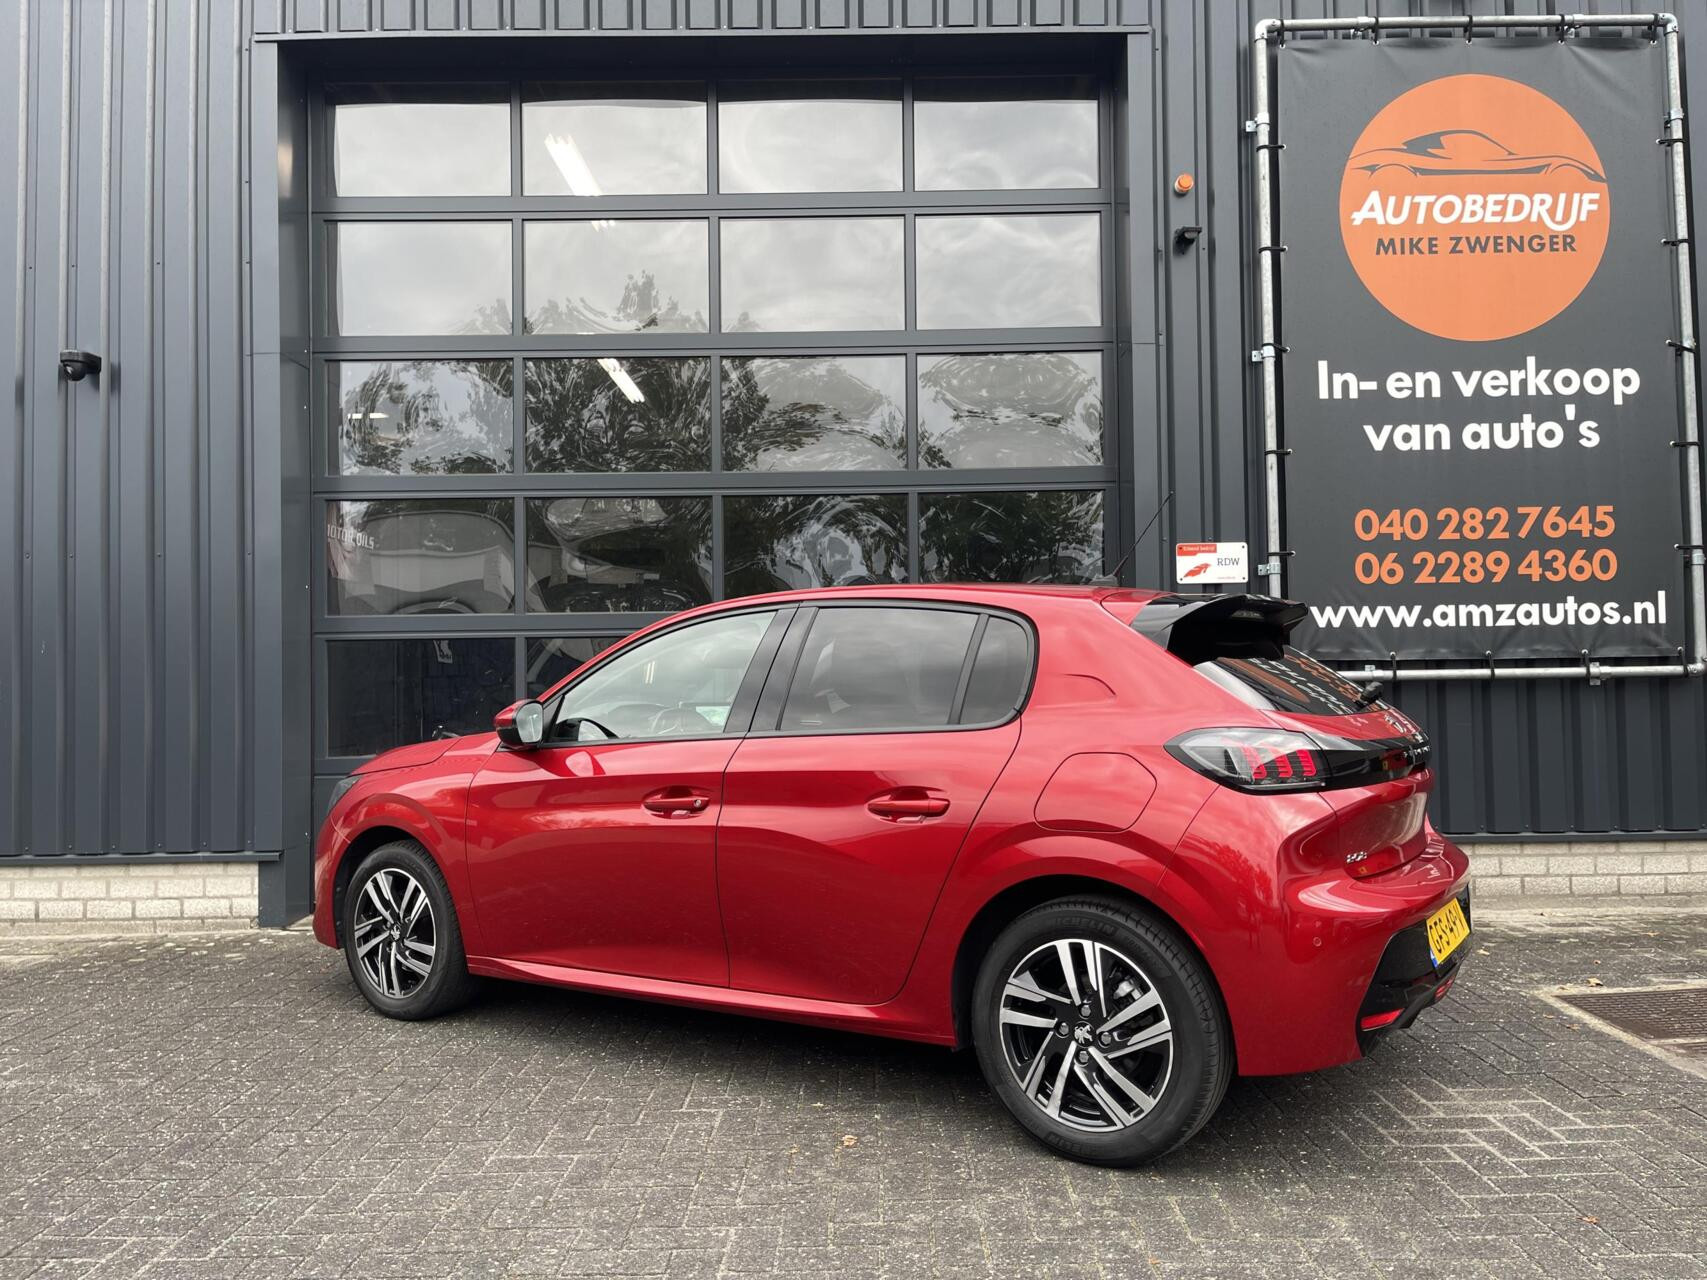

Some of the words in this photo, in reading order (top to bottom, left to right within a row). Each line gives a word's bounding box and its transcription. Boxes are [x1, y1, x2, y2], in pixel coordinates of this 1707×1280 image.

[1351, 190, 1601, 232] AUTOBEDRIJF
[1375, 237, 1439, 256] MIKE
[1449, 234, 1577, 255] ZWENGER
[1317, 359, 1378, 400] In-
[1385, 371, 1442, 399] en
[1451, 355, 1641, 406] verkoop
[1362, 423, 1451, 452] van
[1461, 404, 1601, 451] auto's
[1354, 507, 1429, 542] 040
[1436, 506, 1509, 540] 282
[1517, 505, 1616, 539] 7645
[1216, 557, 1240, 567] RDW
[1354, 551, 1405, 585] 06
[1412, 550, 1511, 584] 2289
[1517, 548, 1618, 582] 4360
[1308, 590, 1667, 629] www.amzautos.nl
